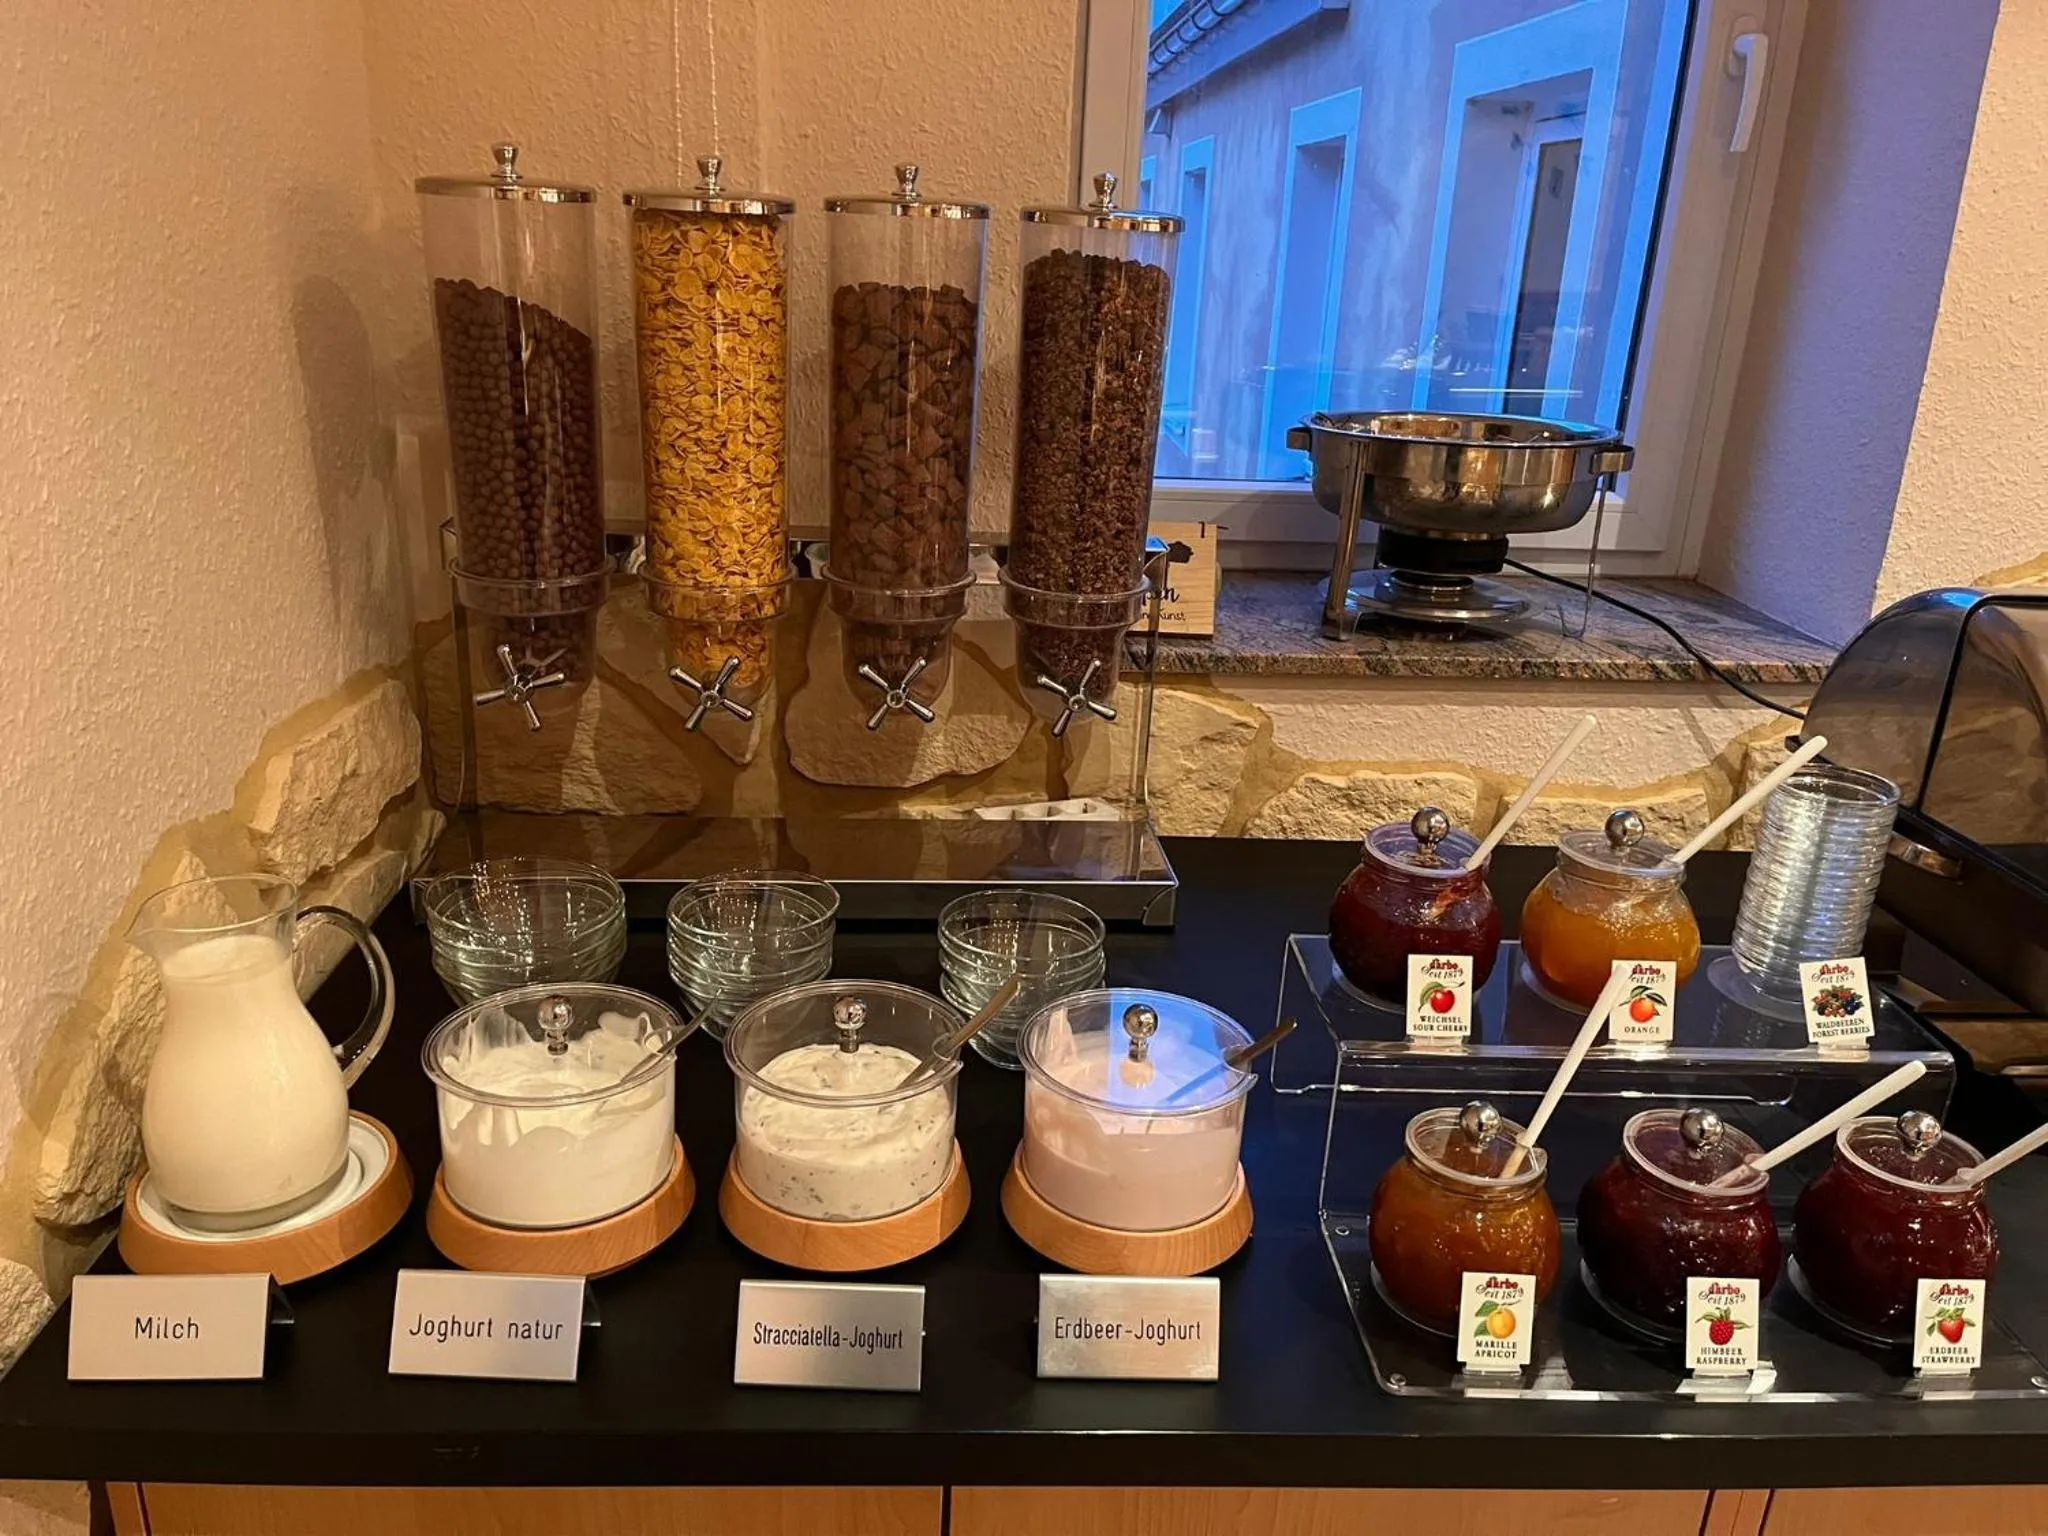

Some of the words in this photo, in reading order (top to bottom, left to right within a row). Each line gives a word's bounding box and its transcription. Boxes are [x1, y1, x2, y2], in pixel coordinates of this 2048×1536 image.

[1420, 1015, 1463, 1024] WEICHSEL
[1816, 1018, 1864, 1029] WALDBEEREN
[1413, 1023, 1434, 1032] SOUR
[1436, 1024, 1468, 1033] CHERRY
[1624, 1026, 1660, 1034] ORANGE
[1812, 1029, 1839, 1038] FOREST
[1841, 1026, 1870, 1036] BERRIES
[1501, 1287, 1525, 1300] 1879
[1724, 1293, 1746, 1305] 1879
[134, 1316, 200, 1339] Milch
[409, 1313, 493, 1343] Joghurt
[508, 1321, 564, 1340] natur
[1055, 1317, 1201, 1346] Erdbeer-Joghurt
[753, 1322, 903, 1355] Stracciatella-Joghurt
[1475, 1340, 1518, 1349] MARILLE
[1474, 1349, 1518, 1359] APRICOT
[1700, 1347, 1743, 1356] HIMBEER
[1930, 1347, 1969, 1355] ERDBEER
[1696, 1357, 1747, 1365] RASPBERRY
[1921, 1356, 1976, 1364] STRAWBERRY
